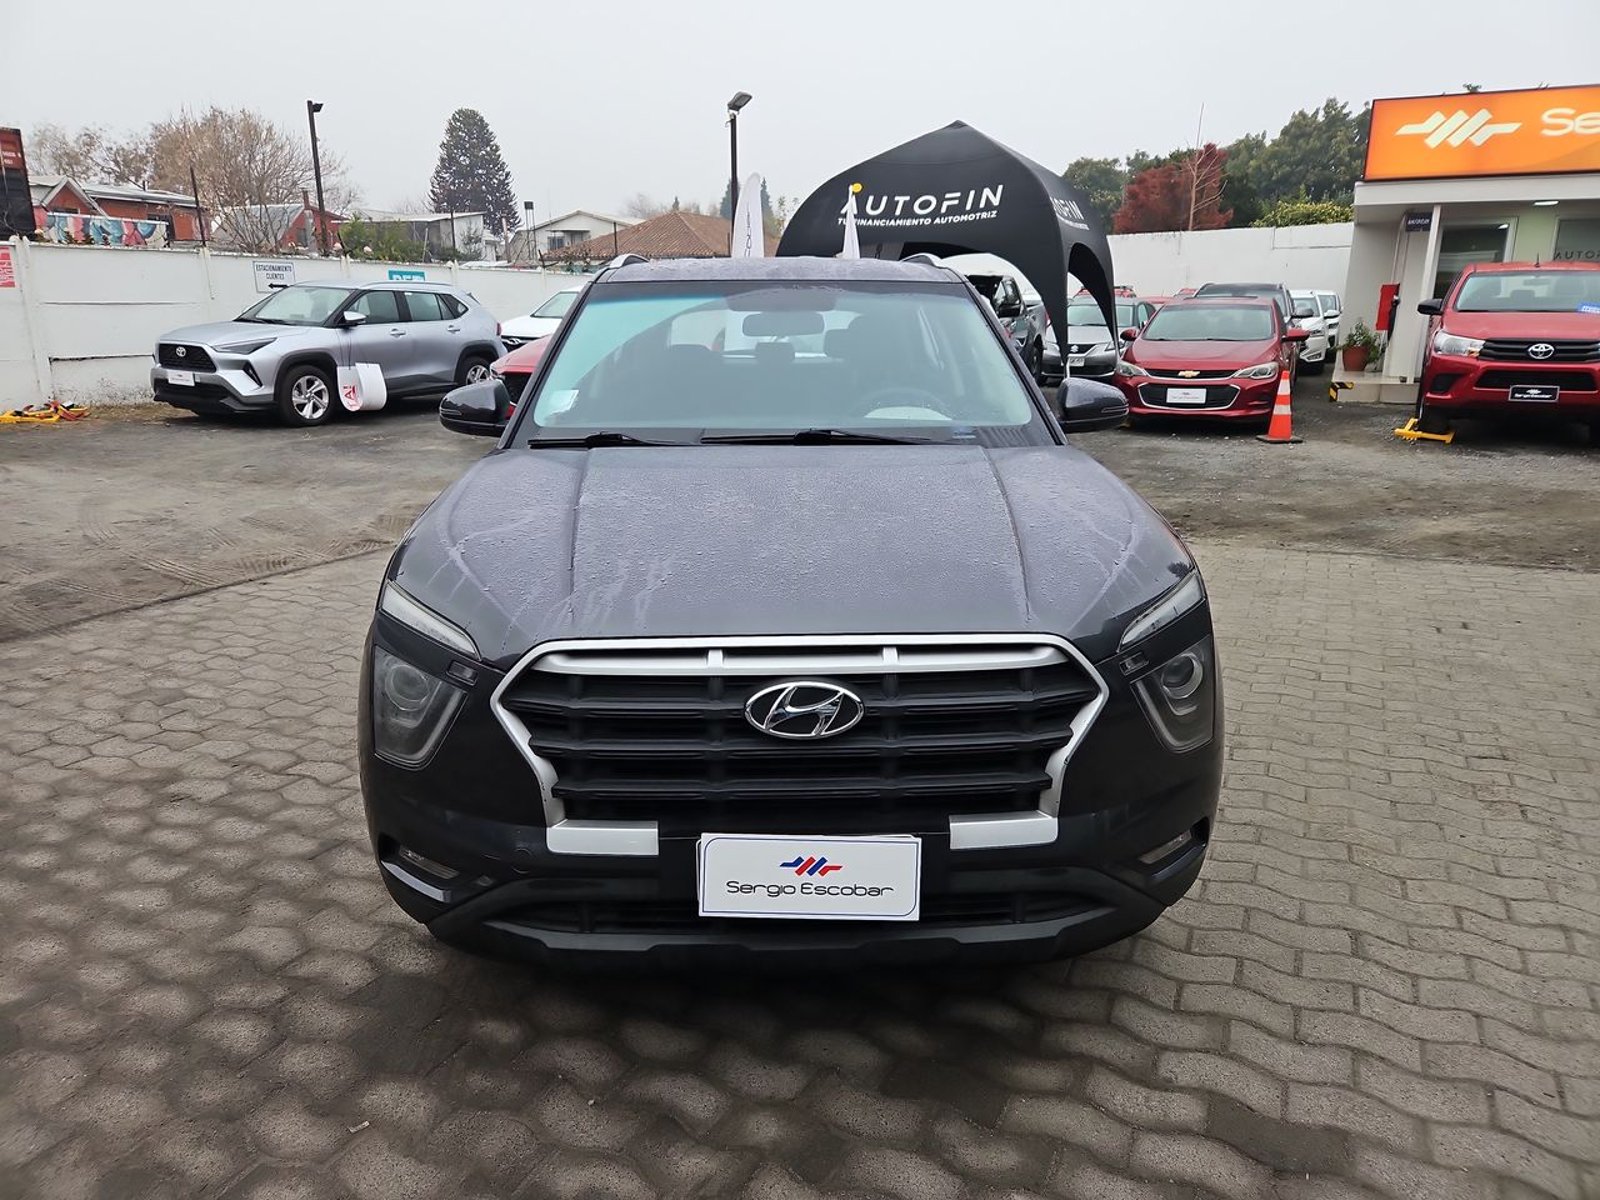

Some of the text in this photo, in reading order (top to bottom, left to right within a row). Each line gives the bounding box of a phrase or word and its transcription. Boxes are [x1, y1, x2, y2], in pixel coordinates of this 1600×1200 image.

[840, 184, 1004, 216] AUTOFIN
[933, 210, 998, 225] AUTOMOTRIZ
[1555, 249, 1600, 260] AUTO
[726, 880, 894, 898] Sergio Escobar
